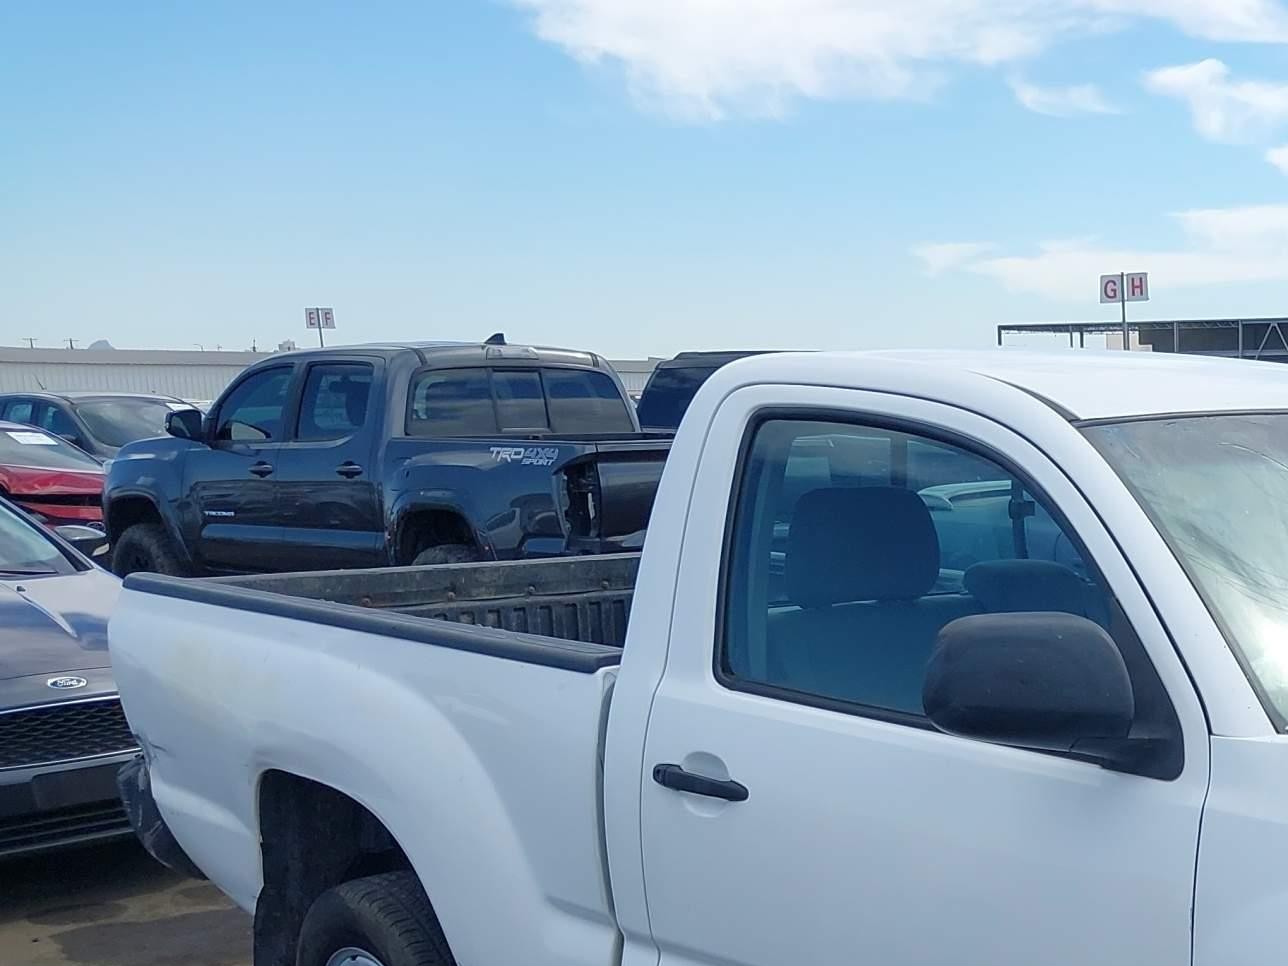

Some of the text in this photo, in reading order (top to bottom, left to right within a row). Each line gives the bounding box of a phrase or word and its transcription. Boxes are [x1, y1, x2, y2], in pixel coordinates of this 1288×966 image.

[1103, 276, 1144, 299] G H
[308, 311, 332, 326] E F
[489, 446, 525, 463] TRD
[521, 458, 555, 466] SPORT
